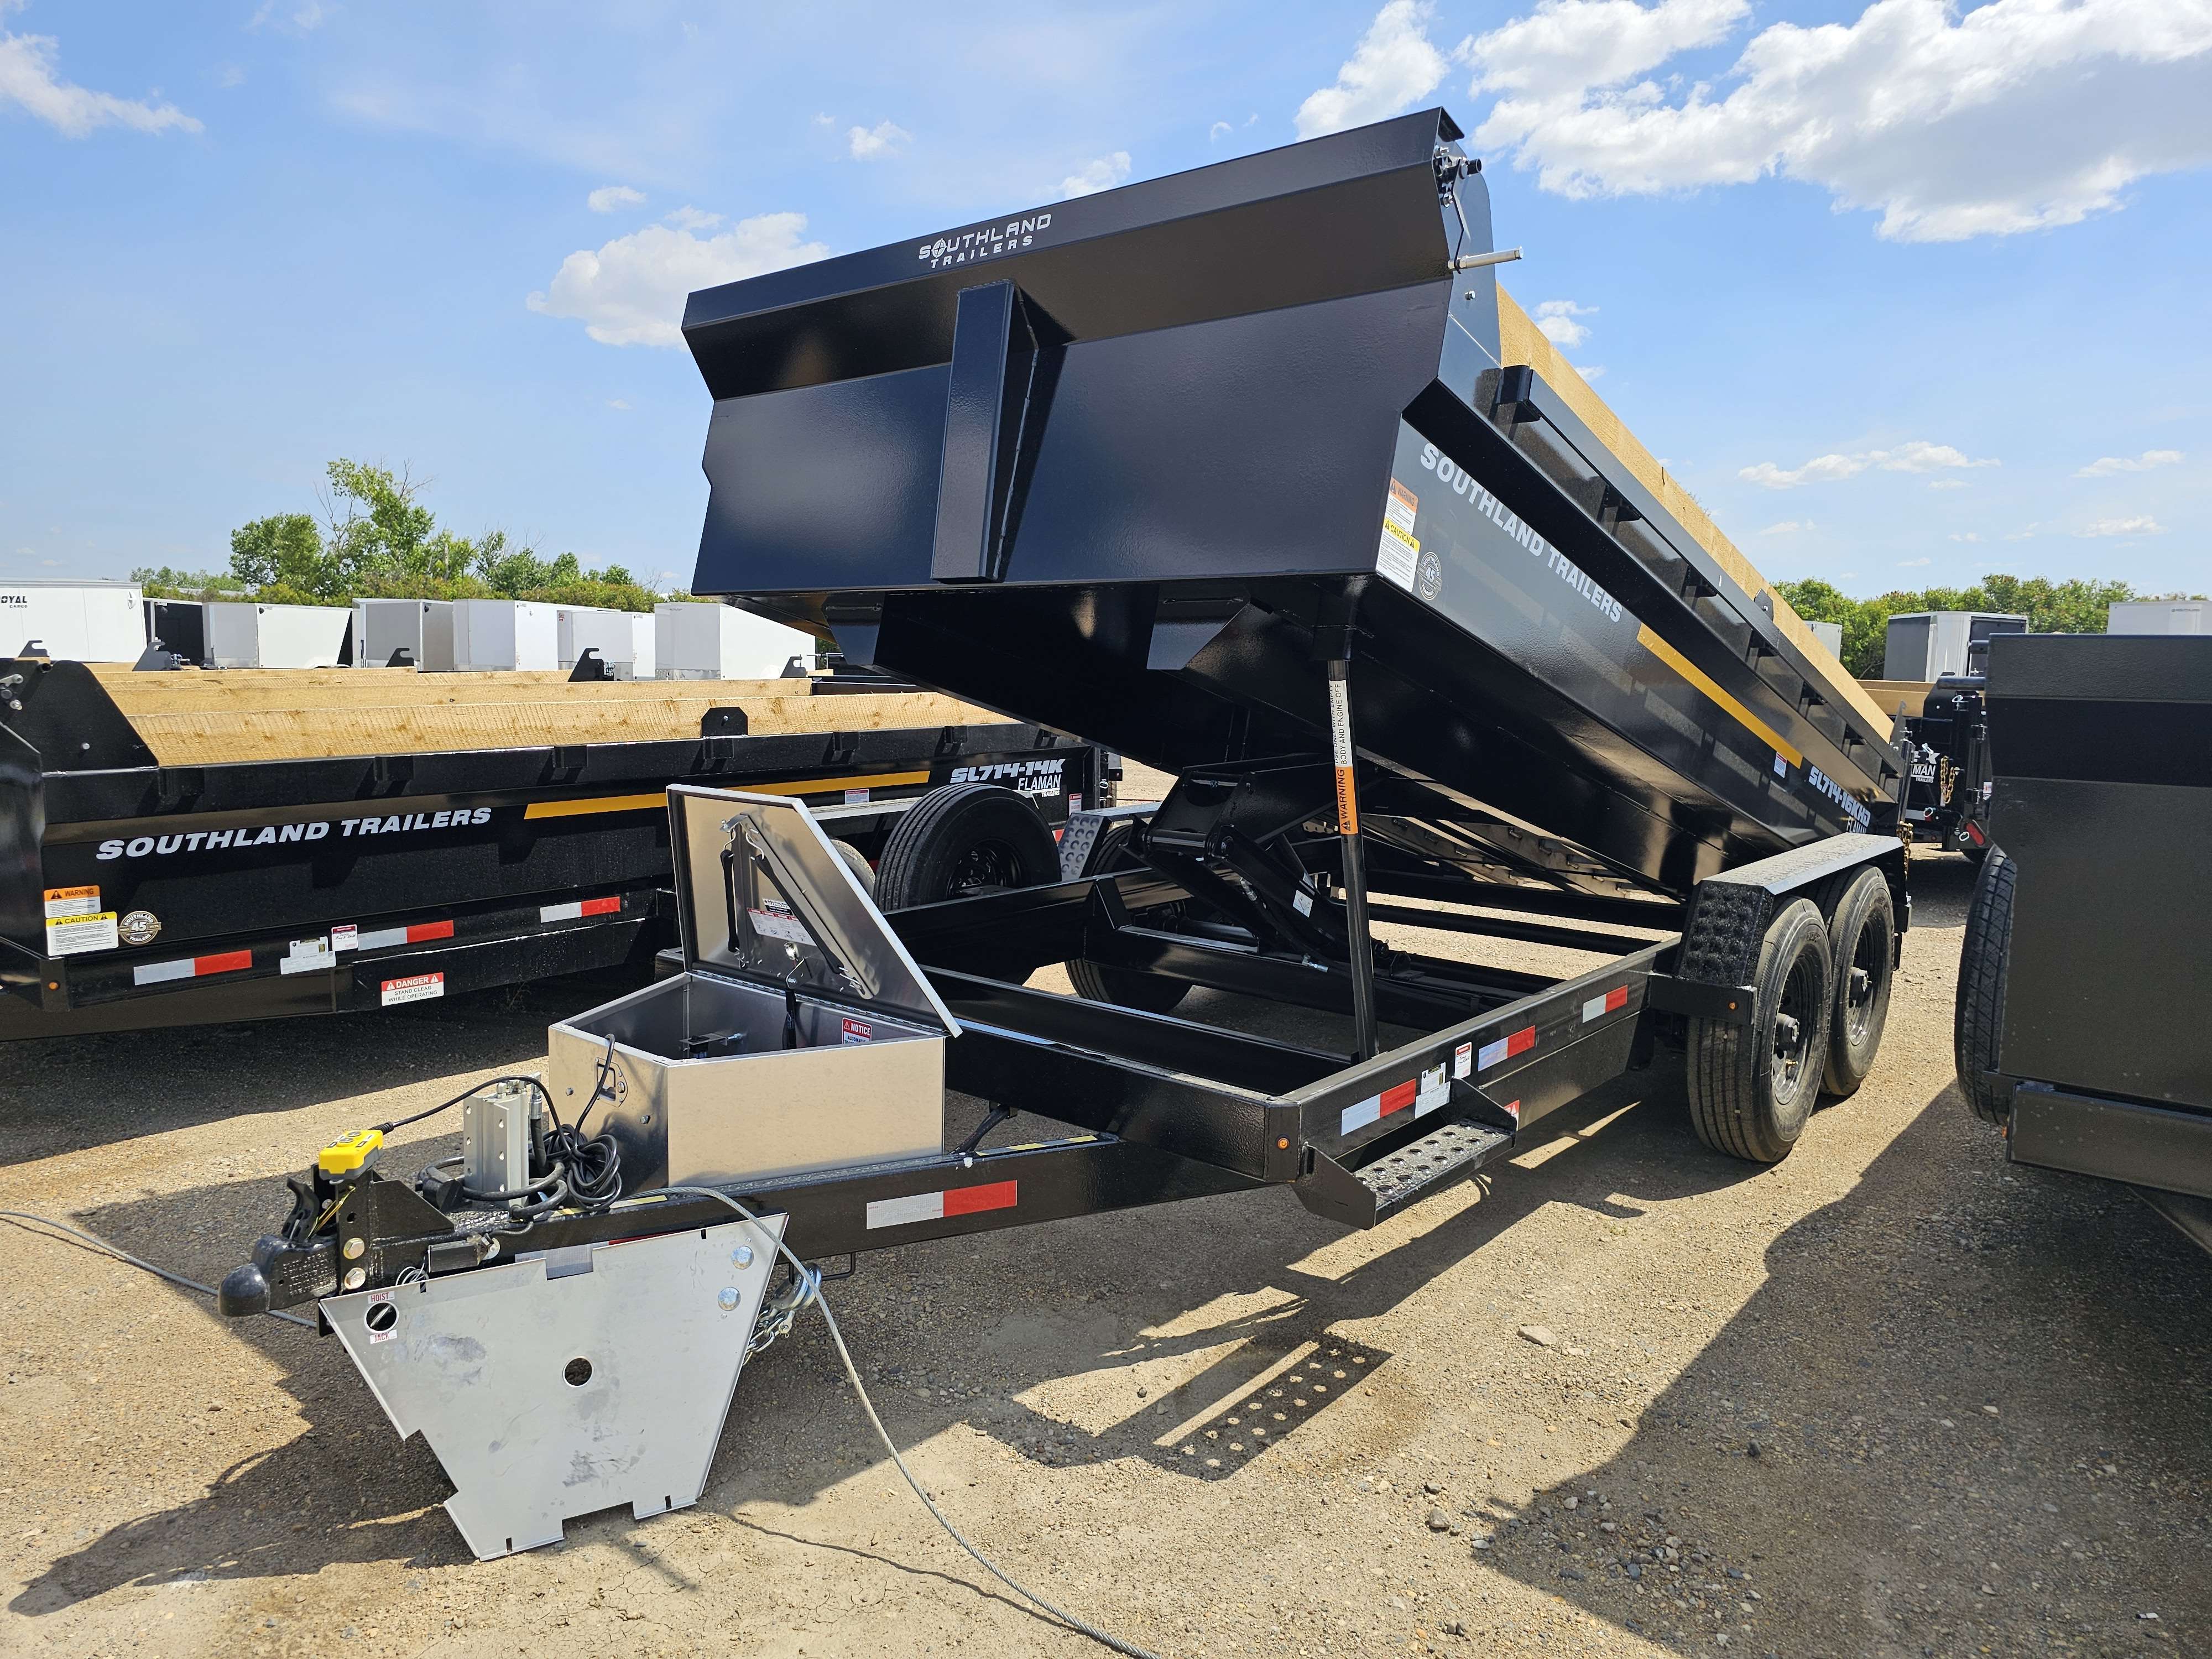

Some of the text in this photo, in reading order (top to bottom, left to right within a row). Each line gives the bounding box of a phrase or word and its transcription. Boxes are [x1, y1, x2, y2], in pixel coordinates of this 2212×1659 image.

[919, 213, 1051, 259] SOUTHLAND
[931, 235, 1032, 269] TRAILERS
[1397, 487, 1415, 507] WARNING
[1390, 524, 1410, 544] CAUTION
[1420, 442, 1545, 557] SOUTHLAND
[1547, 545, 1623, 623] TRAILERS
[1425, 566, 1436, 583] 45
[950, 758, 1066, 784] SL714-14K
[1912, 764, 1936, 776] MAN
[1018, 774, 1061, 791] FLAMAN
[1337, 769, 1347, 819] WARNING
[1808, 765, 1871, 828] SL714-16KHD
[96, 807, 492, 860] SOUTHLAND TRAILERS
[64, 888, 94, 897] WARNING
[65, 915, 98, 924] CAUTION
[124, 914, 154, 926] SOUTHLAND
[132, 921, 147, 932] 45
[396, 977, 429, 988] DANGER
[407, 990, 437, 999] OPERATING
[851, 1022, 870, 1036] NOTICE
[371, 1292, 389, 1302] HOIST
[374, 1332, 389, 1342] JACK
